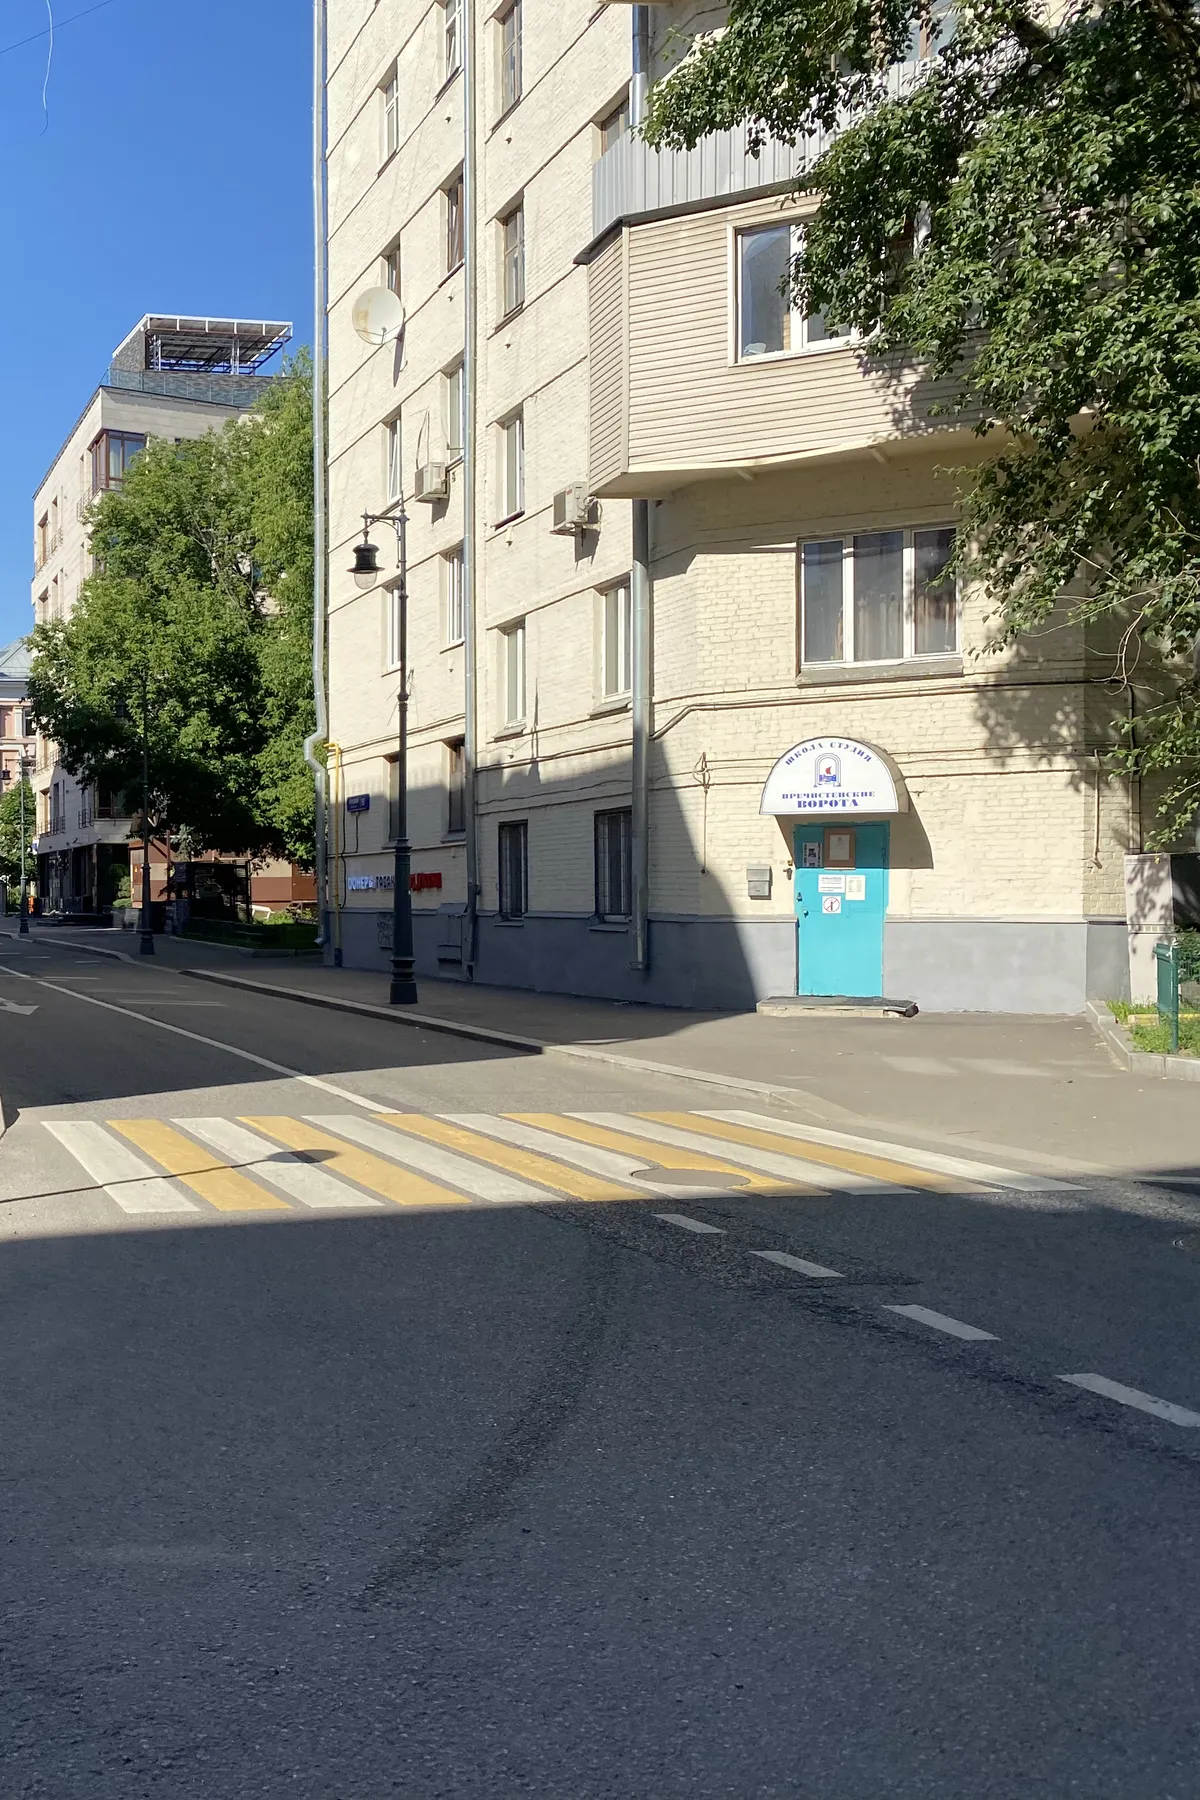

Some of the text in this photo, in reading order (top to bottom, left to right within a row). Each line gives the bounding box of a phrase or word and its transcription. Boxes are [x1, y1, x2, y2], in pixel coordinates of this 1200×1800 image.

[785, 741, 872, 766] ШКОЛА СТУДИЯ
[781, 791, 875, 799] ПРЕЧИСТЕНСКИЕ
[797, 798, 859, 808] ВОРОТА
